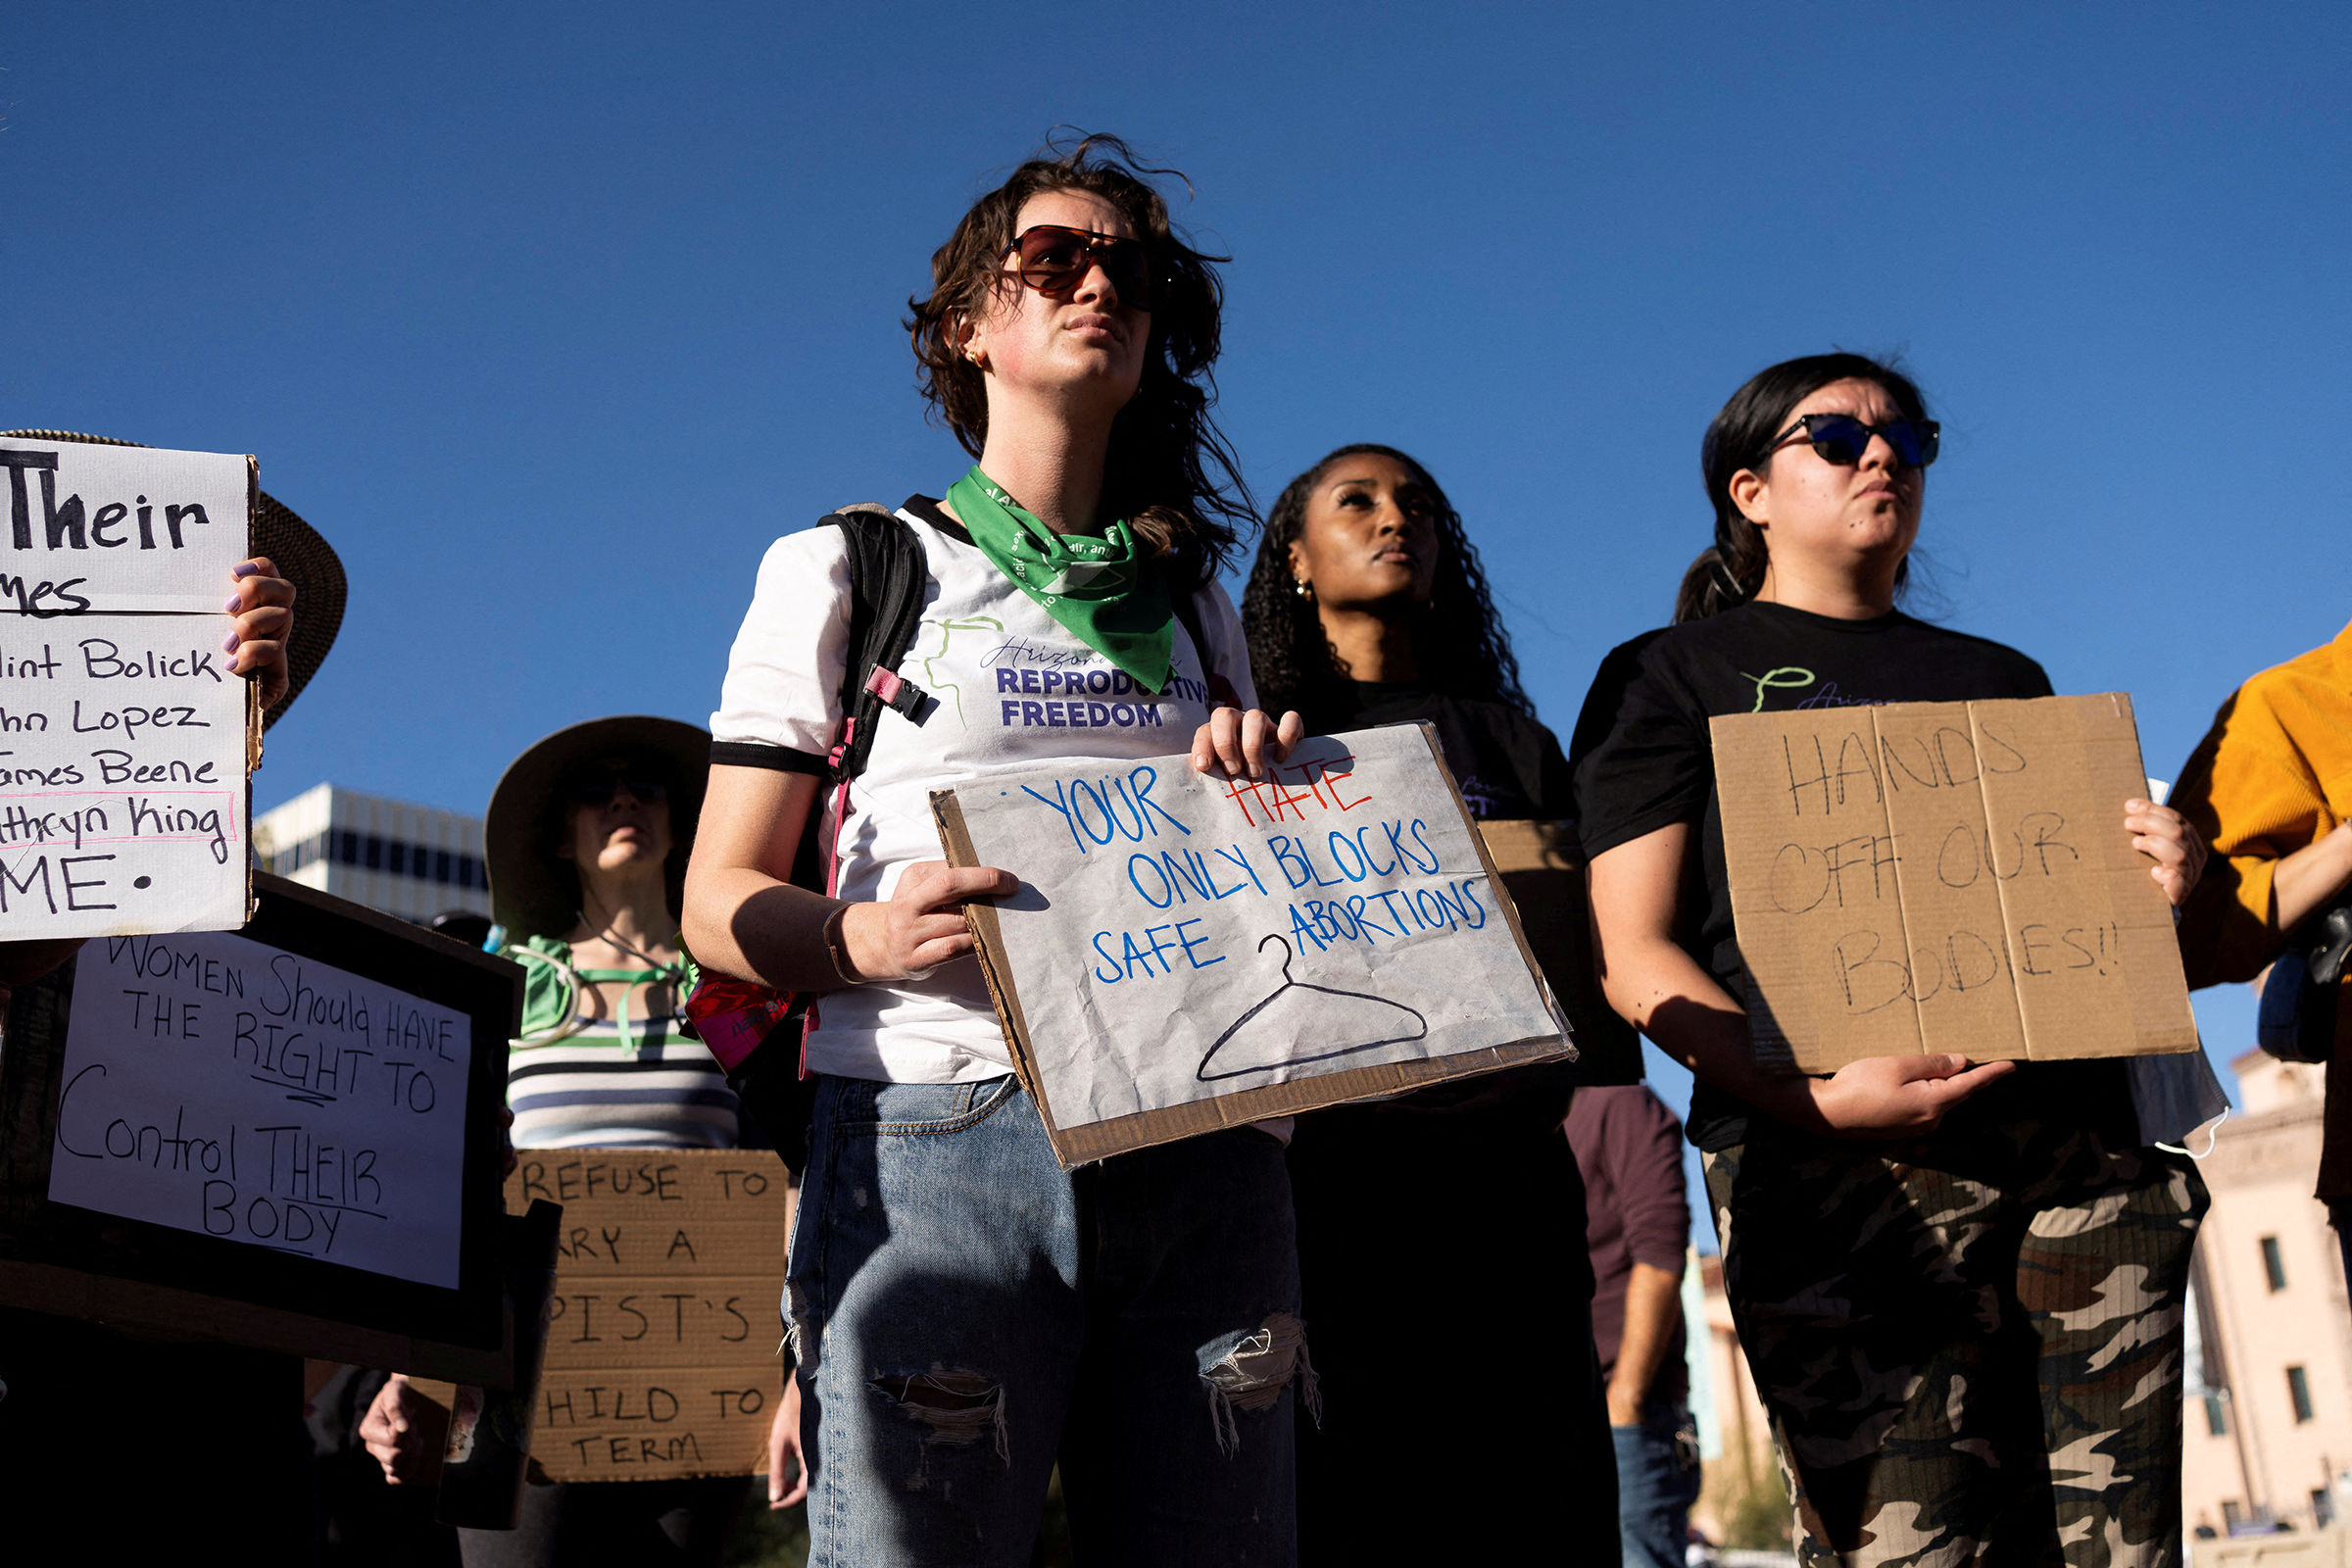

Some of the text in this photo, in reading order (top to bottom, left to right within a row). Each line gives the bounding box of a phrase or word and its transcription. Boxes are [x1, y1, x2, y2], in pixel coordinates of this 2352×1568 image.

[0, 450, 209, 551] Their
[78, 638, 222, 682] Bolick
[74, 700, 210, 741] Lopez
[1002, 699, 1163, 728] FREEDOM
[91, 749, 219, 785] Beene
[1784, 720, 2026, 816] HANDS
[129, 796, 226, 865] King
[1021, 755, 1373, 855] YOUR HATE
[1128, 818, 1441, 910] ONLY BLOCKS
[1770, 811, 2079, 915] OFF OUR
[1092, 880, 1488, 984] SAFE ABORTIONS
[1833, 921, 2119, 1015] BODIES!!
[107, 934, 244, 1000] WOMEN
[387, 1004, 454, 1062] HAVE
[731, 990, 791, 1038] nalgene
[123, 989, 435, 1113] THE RIGHT TO
[58, 1064, 382, 1204] Control THEIR
[204, 1180, 342, 1253] BODY
[521, 1160, 767, 1202] REFUSE TO
[557, 1226, 696, 1264] RY A
[710, 1388, 763, 1418] TO
[571, 1433, 703, 1467] TERM
